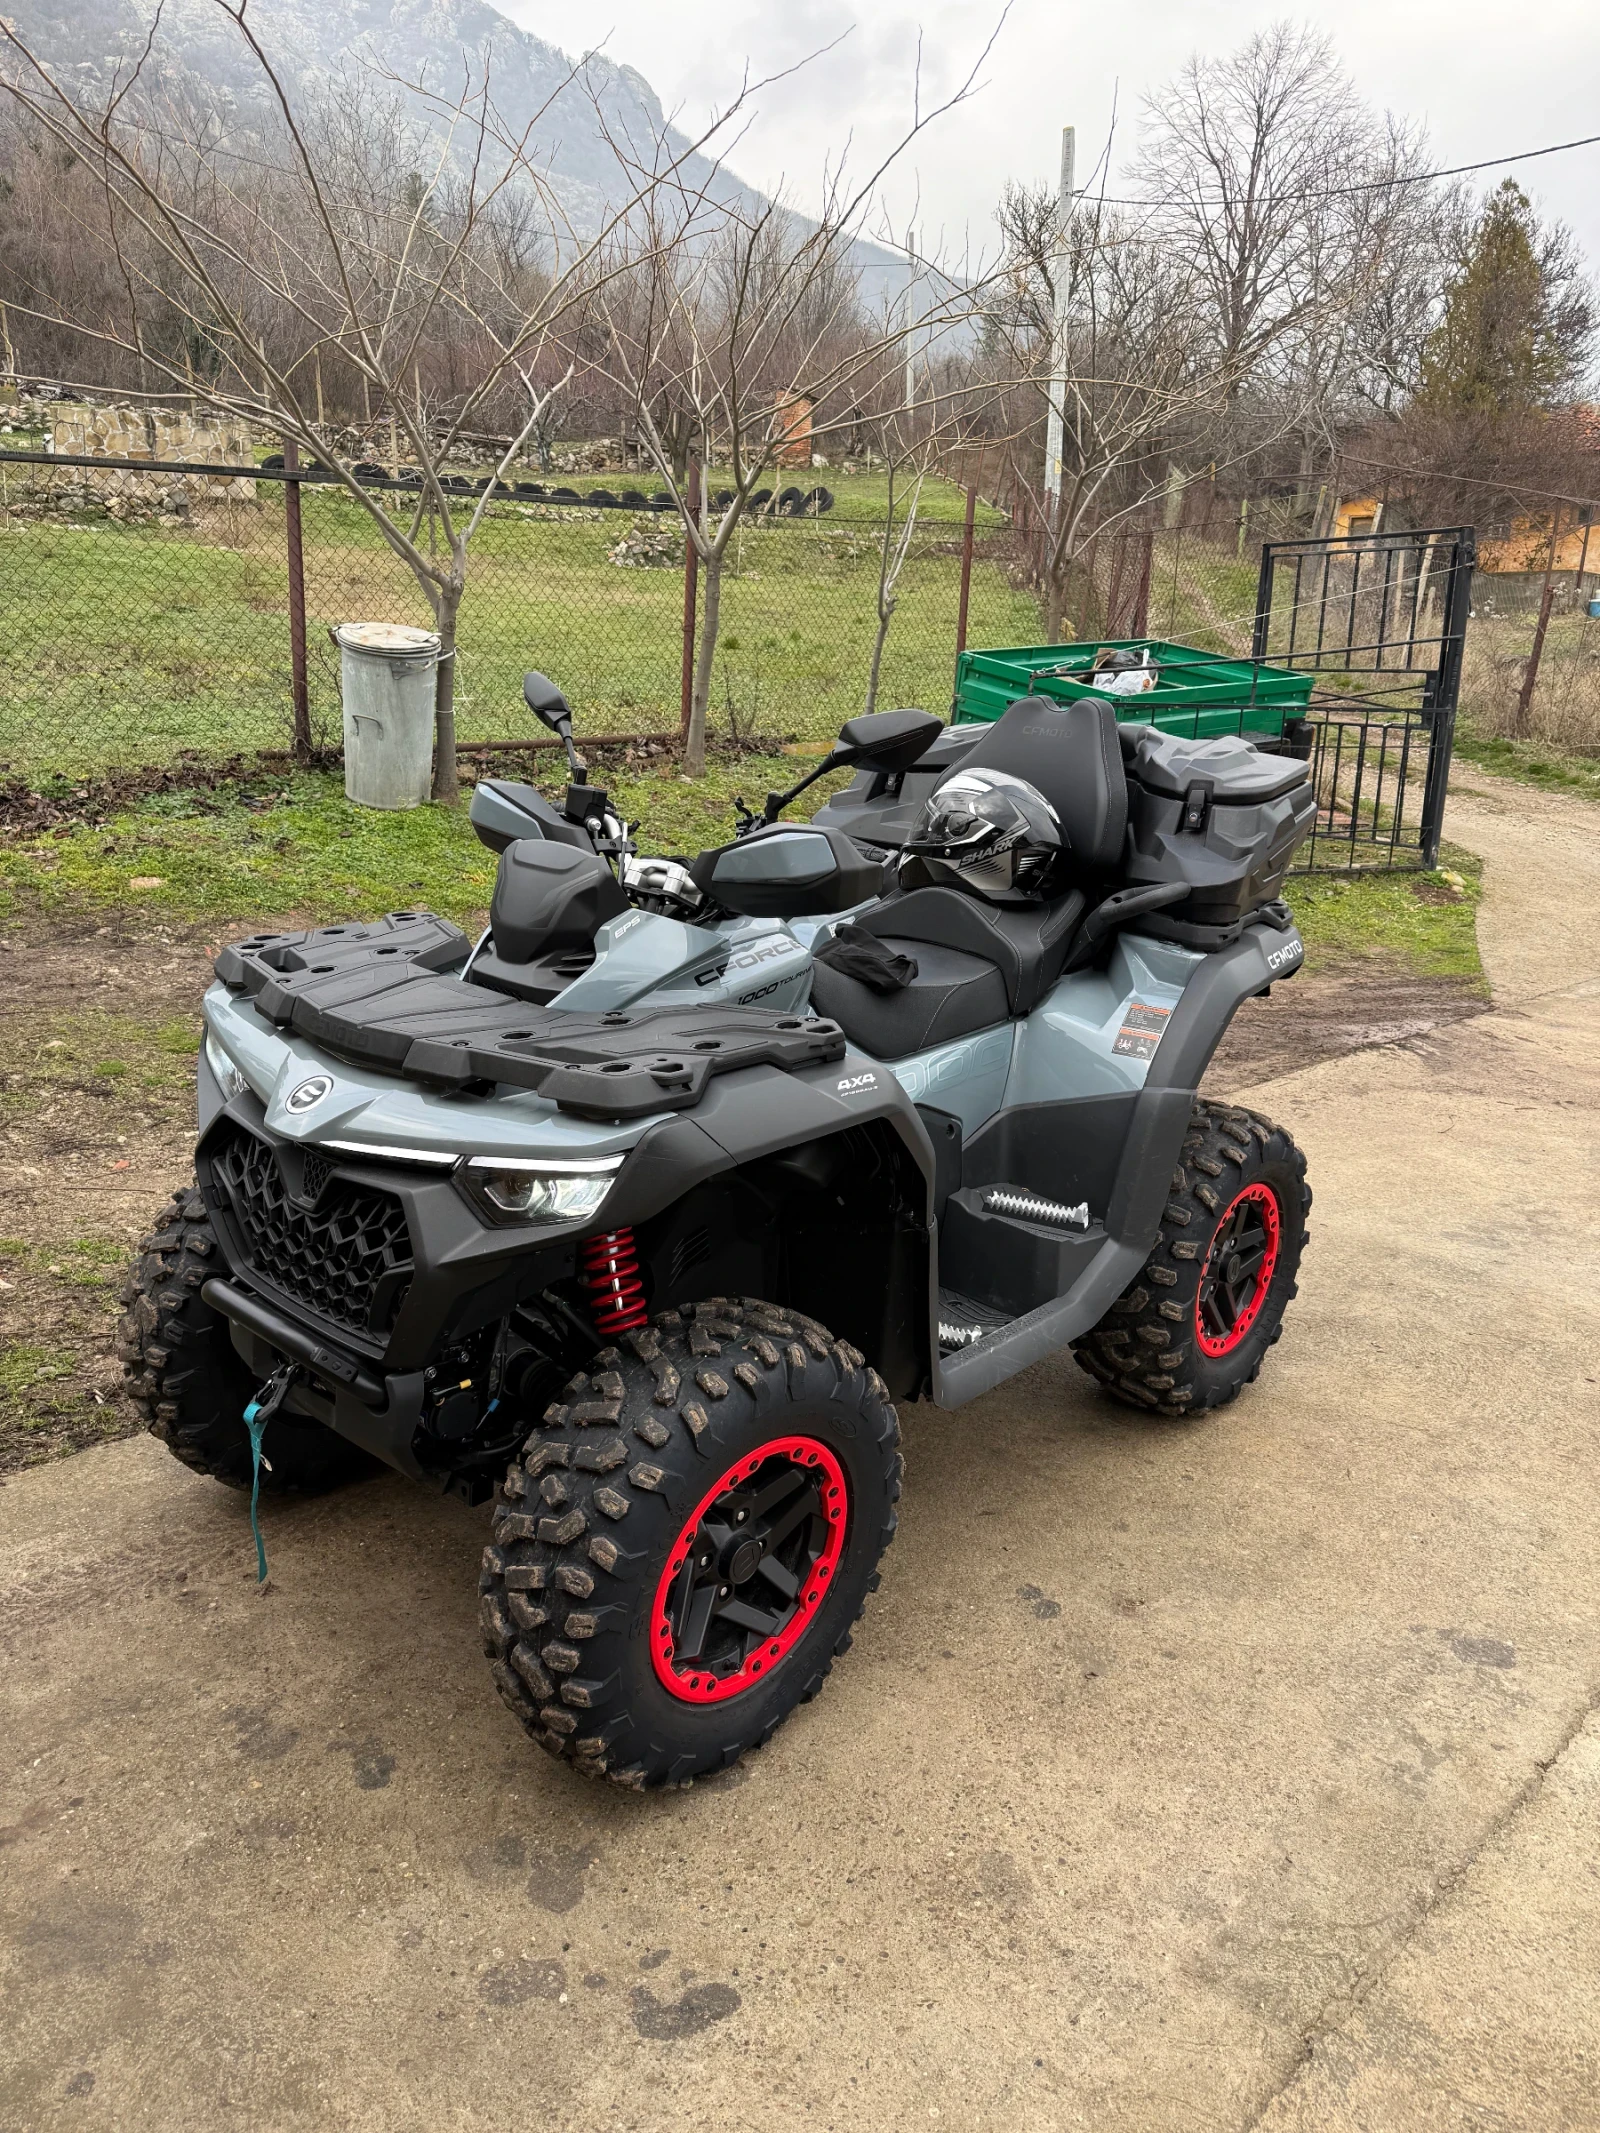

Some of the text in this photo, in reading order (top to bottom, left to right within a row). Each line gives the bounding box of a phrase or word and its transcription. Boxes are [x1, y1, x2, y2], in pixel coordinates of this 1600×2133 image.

[1023, 726, 1072, 738] CFMOTO
[961, 837, 1018, 866] SHARK
[615, 915, 640, 939] EPS
[1267, 939, 1302, 970] CFMOTO
[738, 982, 780, 1005] 1000
